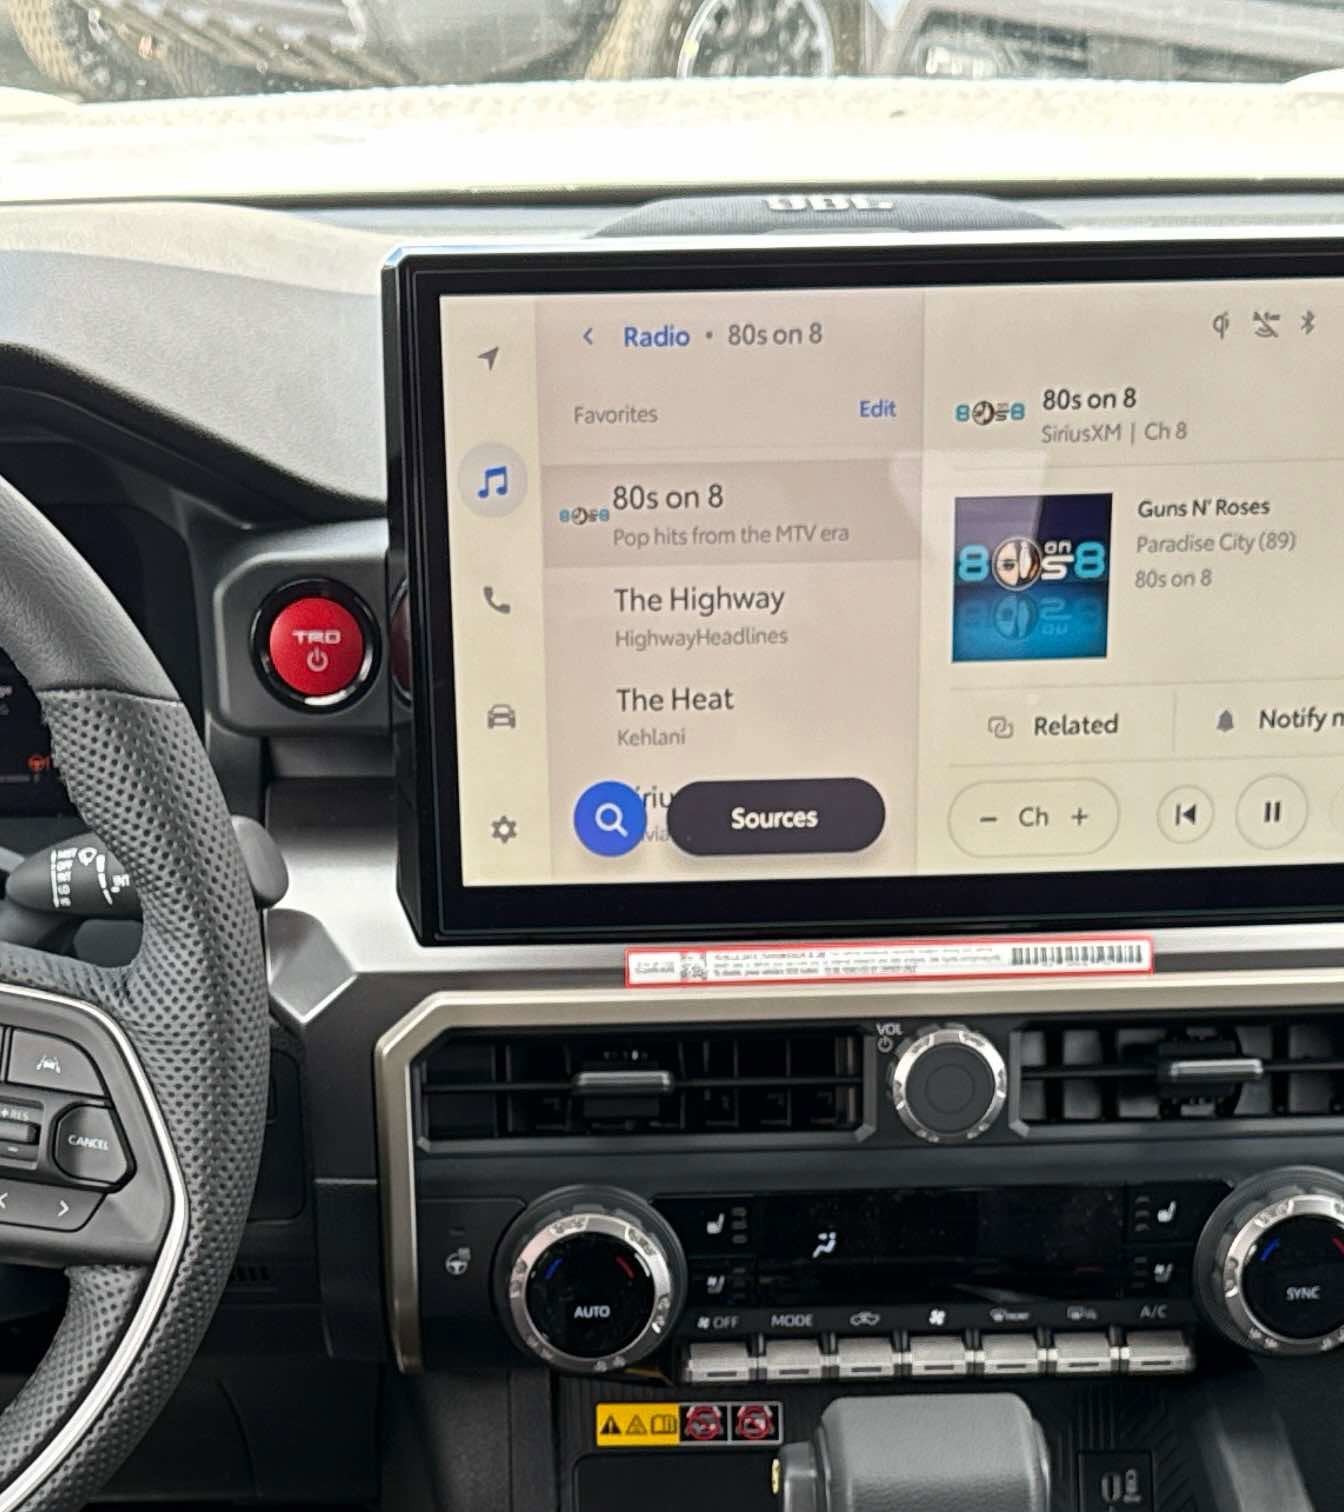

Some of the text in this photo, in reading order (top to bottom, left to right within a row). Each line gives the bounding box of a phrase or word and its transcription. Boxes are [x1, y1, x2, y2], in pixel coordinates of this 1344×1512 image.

[623, 324, 823, 349] Radio 80s on 8
[858, 399, 897, 419] Edit
[1042, 387, 1137, 411] 80s on 8
[572, 405, 658, 426] Favorites
[1041, 422, 1188, 444] SiriusXM Ch 8
[612, 484, 724, 511] 80s on 8
[1137, 499, 1188, 519] Guns
[1216, 498, 1270, 518] Roses
[612, 525, 849, 548] Pop hits from the MTV era
[1136, 531, 1297, 555] Paradise City (89)
[1135, 569, 1213, 589] 80s on 8
[614, 585, 786, 616] The Highway
[291, 629, 343, 646] TRD
[615, 628, 789, 650] HighwayHeadlines
[616, 687, 734, 712] The Heat
[1033, 714, 1119, 737] Related
[1258, 708, 1327, 734] Notify
[616, 728, 687, 747] Kehlani
[730, 806, 819, 831] Sources
[1018, 807, 1050, 828] Ch
[876, 1023, 904, 1036] VOL
[68, 1134, 109, 1152] CANCEL
[1286, 1286, 1321, 1301] SYNC
[573, 1305, 611, 1320] AUTO
[770, 1313, 814, 1328] MODE
[1139, 1304, 1168, 1319] A/C
[712, 1315, 740, 1330] OFF
